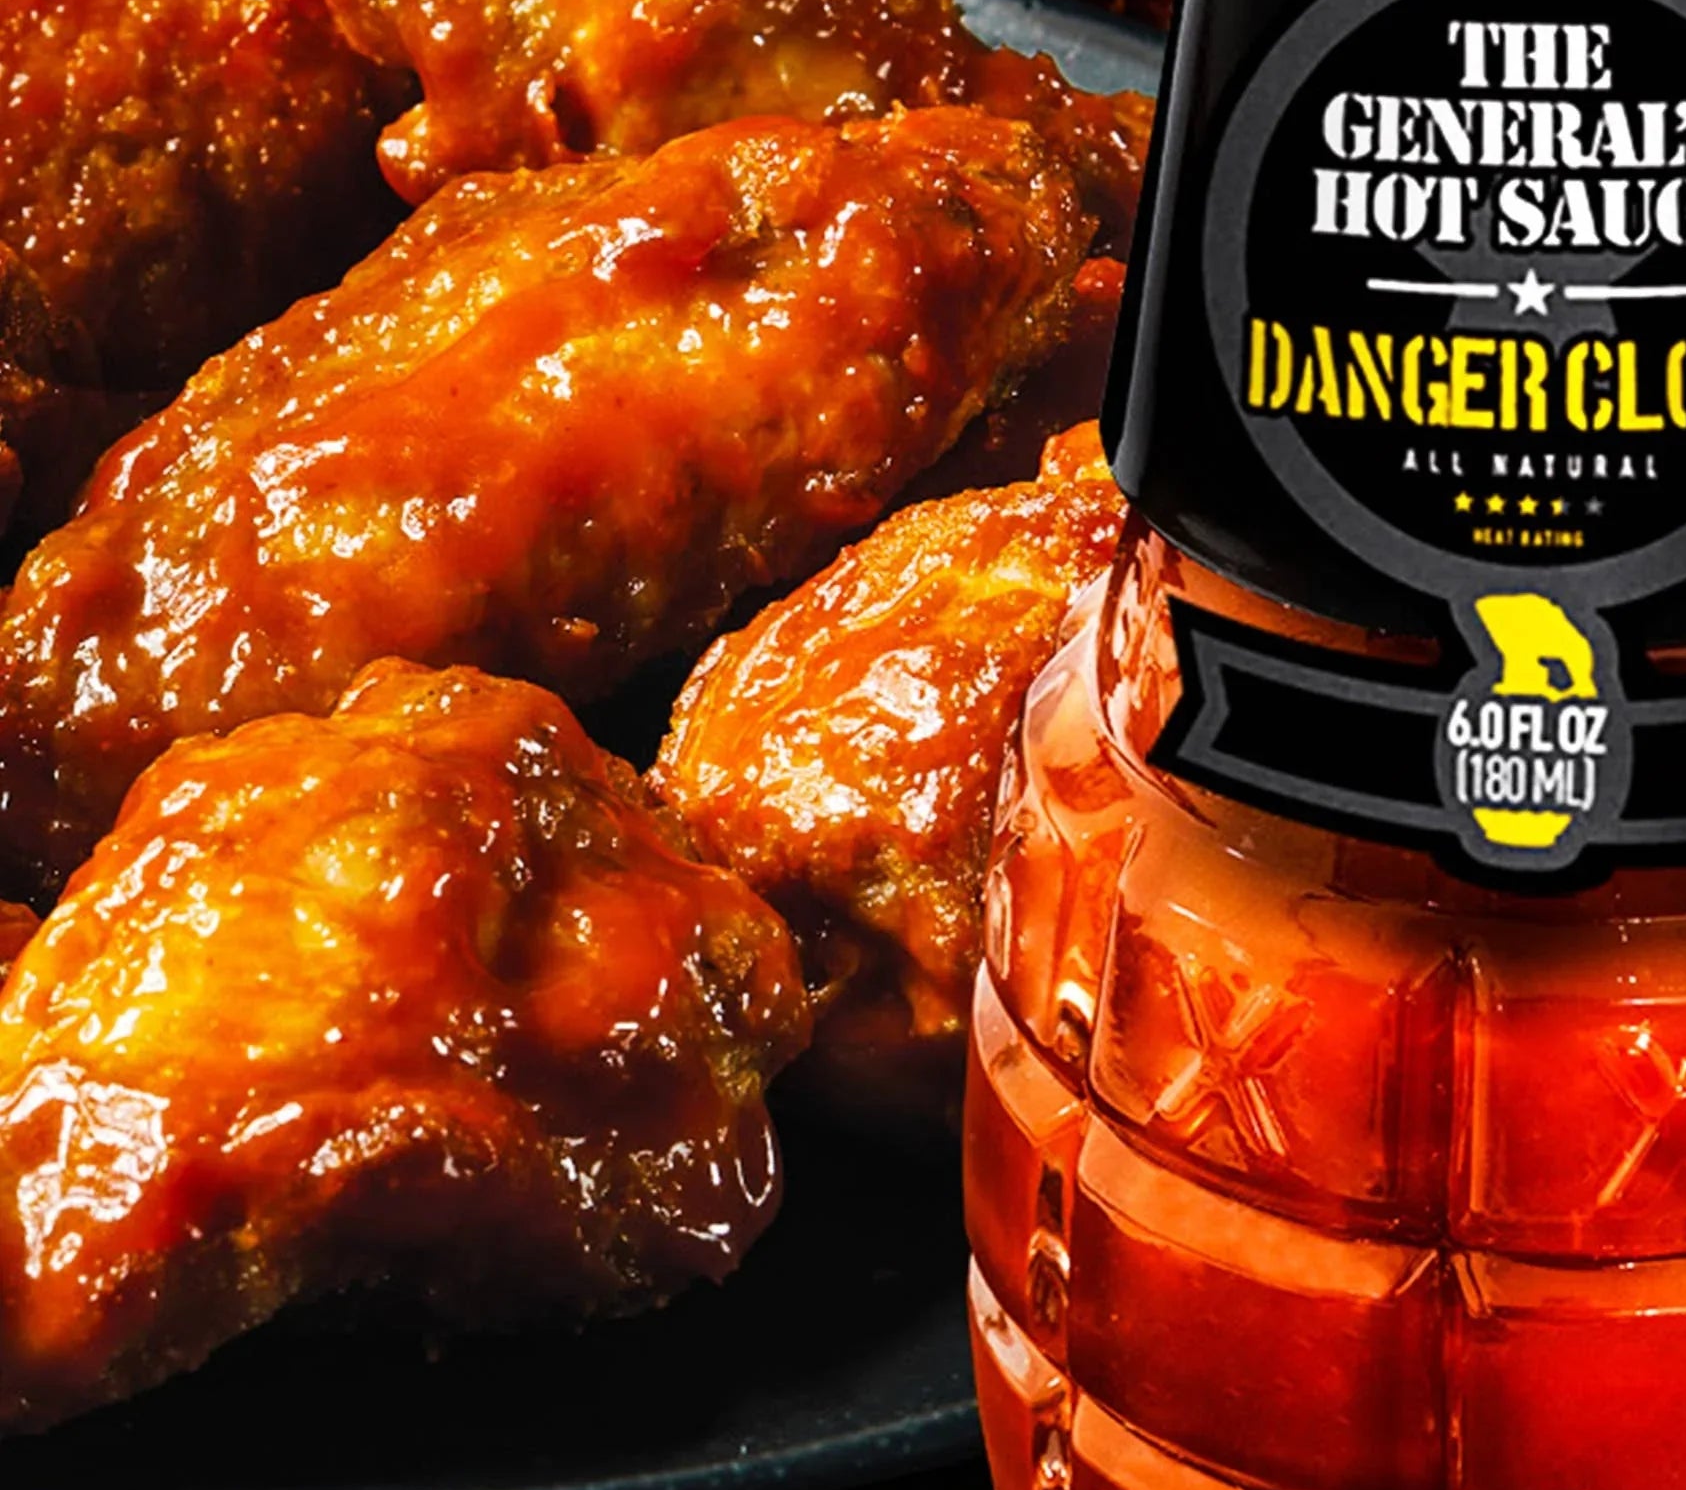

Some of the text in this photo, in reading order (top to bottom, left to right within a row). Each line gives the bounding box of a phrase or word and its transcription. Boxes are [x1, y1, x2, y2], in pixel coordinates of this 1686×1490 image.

[1449, 21, 1612, 90] THE
[1311, 169, 1478, 242] HOT
[1248, 319, 1548, 430] DANGER
[1403, 449, 1658, 478] ALL NATURAL
[1447, 700, 1607, 755] 6.0 FL OZ
[1456, 751, 1594, 810] (180 ML)
